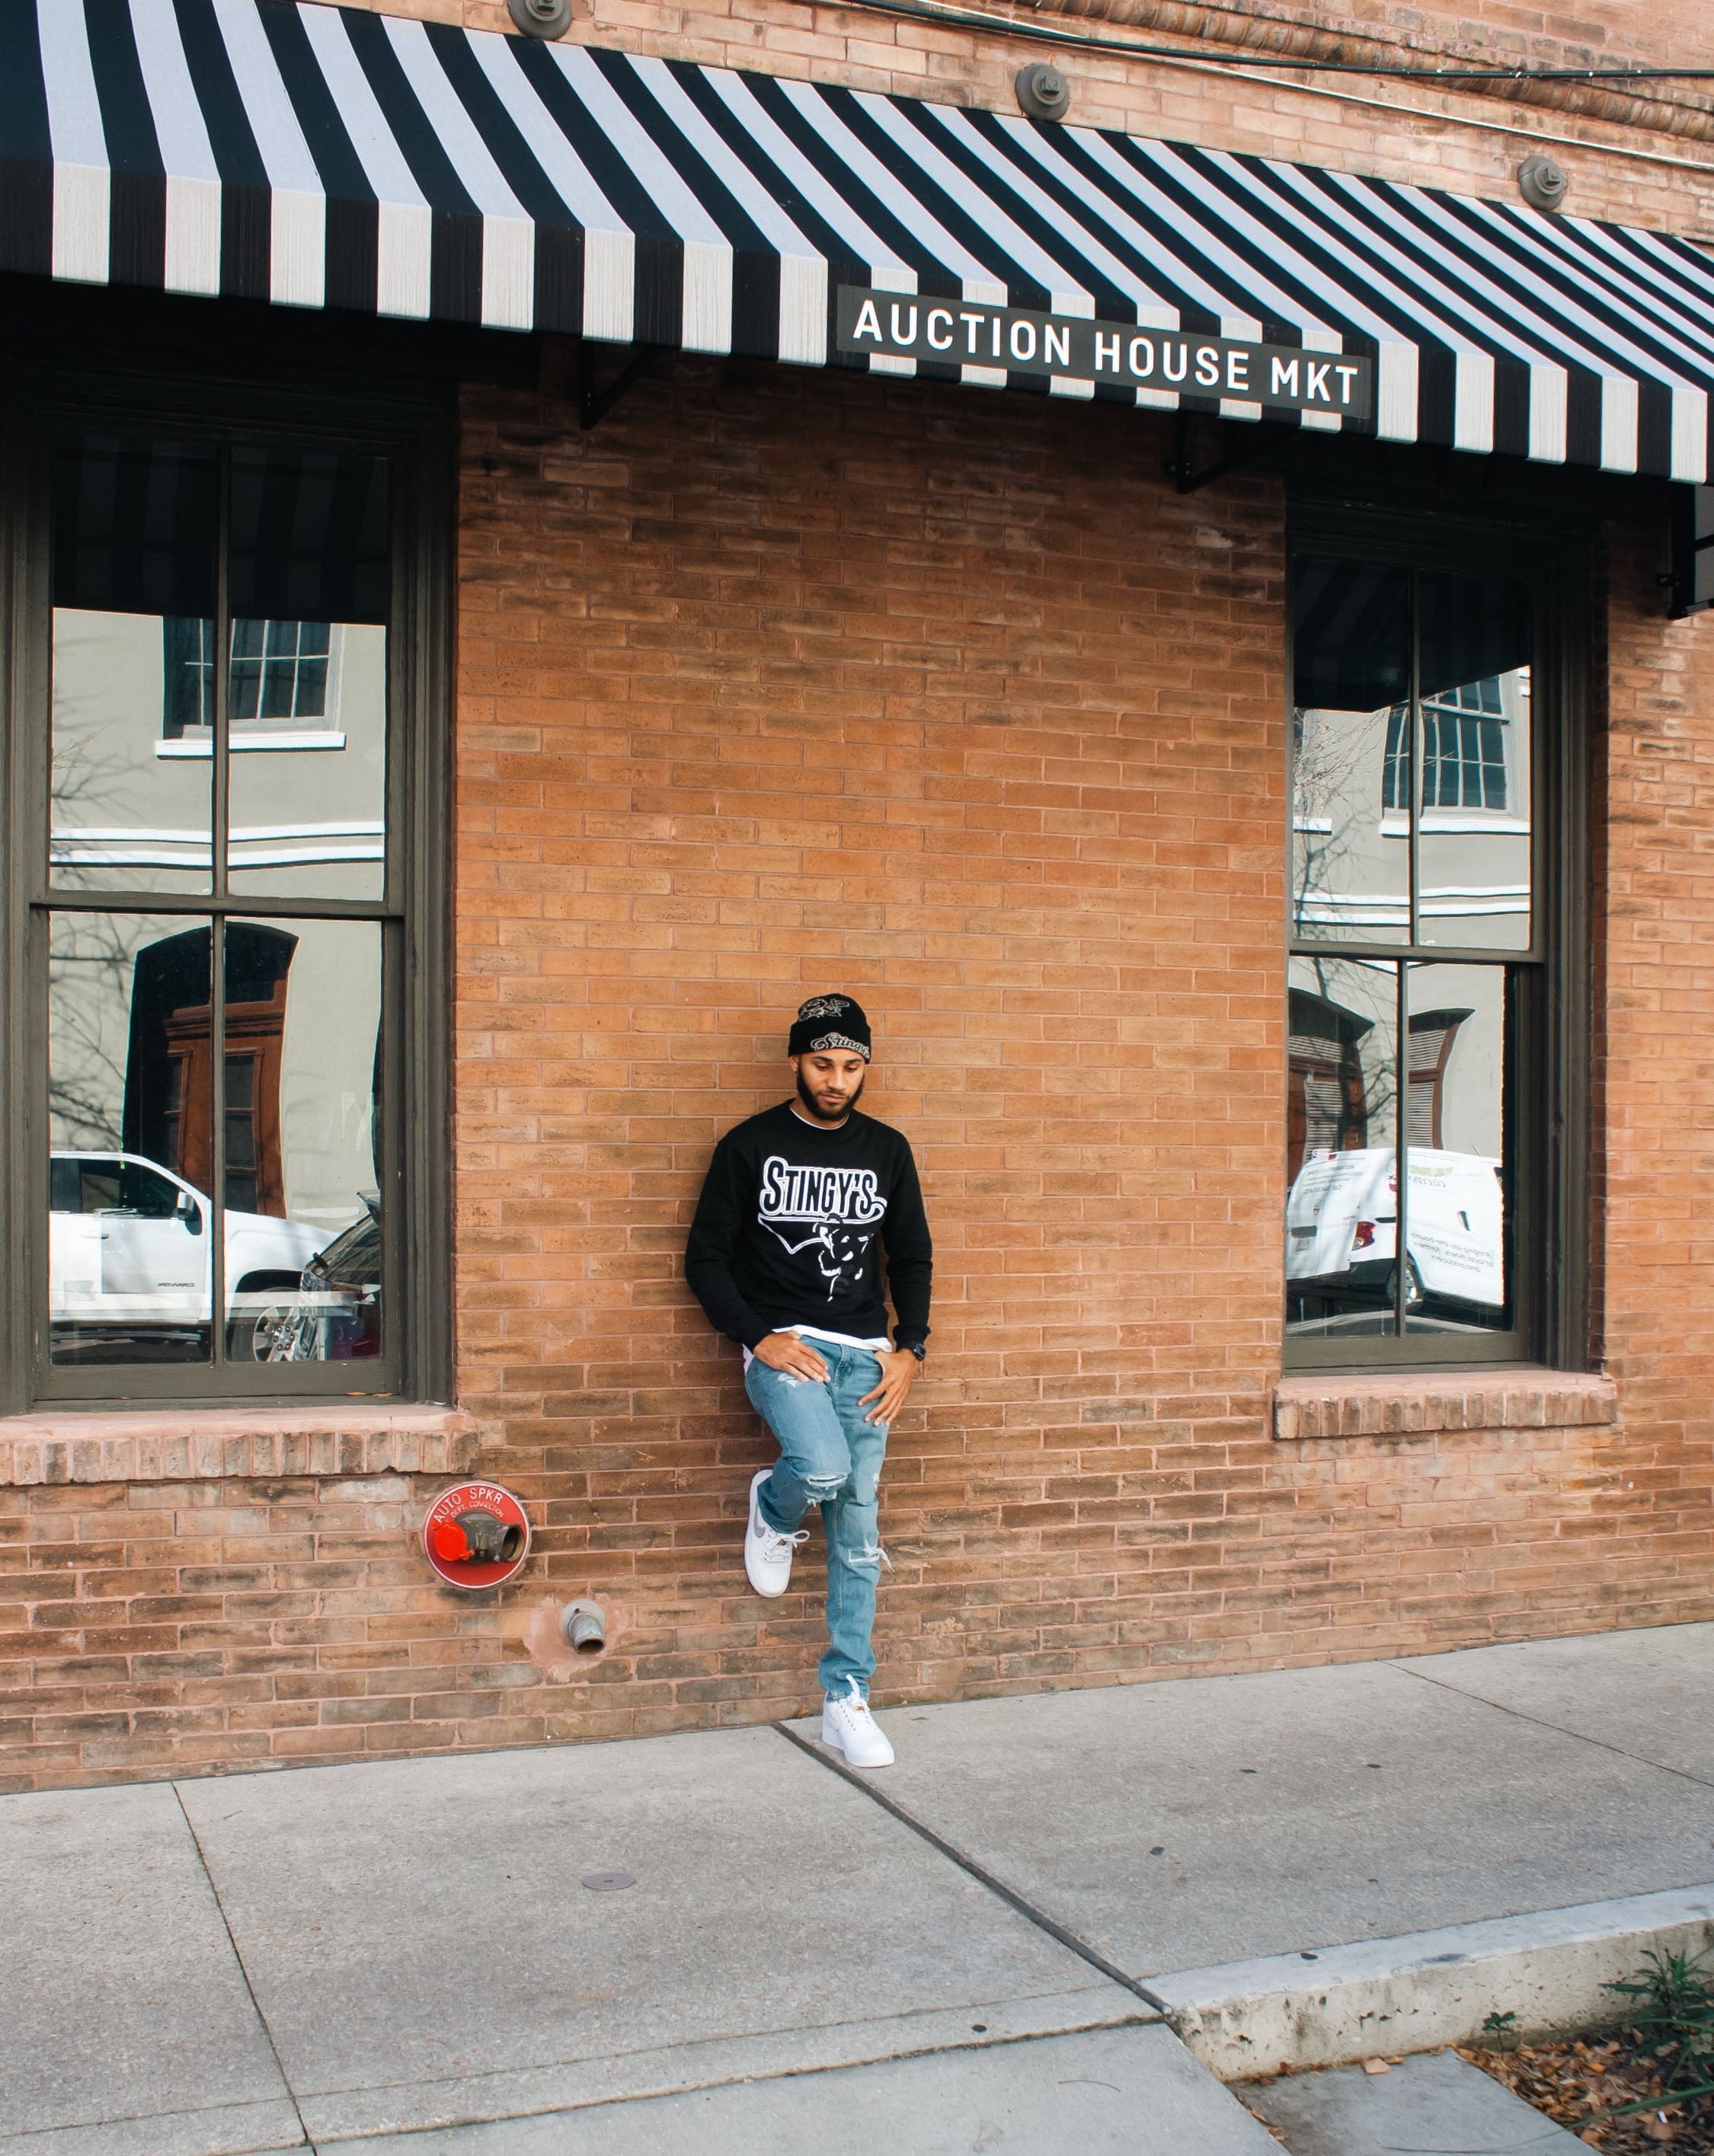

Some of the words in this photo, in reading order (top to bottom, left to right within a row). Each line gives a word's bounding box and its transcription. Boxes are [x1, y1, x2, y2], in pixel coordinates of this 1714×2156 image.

[853, 299, 1070, 366] AUCTION
[1095, 331, 1249, 390] HOUSE
[1270, 356, 1359, 404] MKT
[759, 1156, 878, 1219] STINGY'S
[433, 1493, 461, 1523] AUTO
[469, 1487, 503, 1505] SPKR
